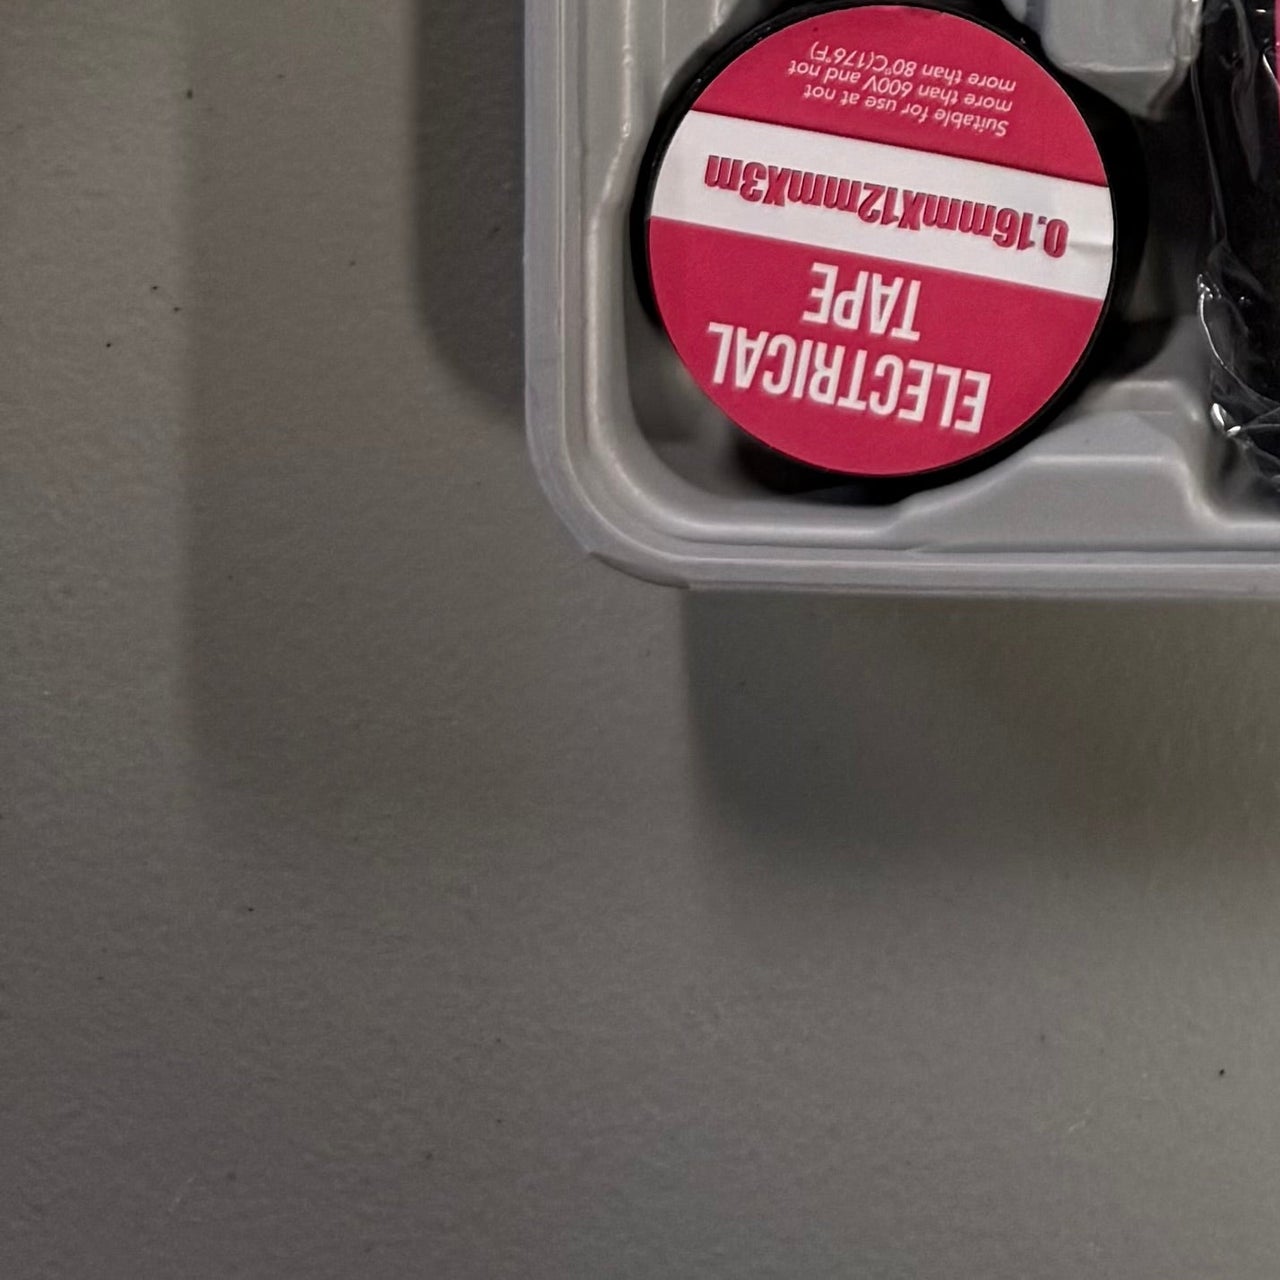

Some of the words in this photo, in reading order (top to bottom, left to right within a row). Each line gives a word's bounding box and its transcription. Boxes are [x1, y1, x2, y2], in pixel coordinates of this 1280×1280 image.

[788, 60, 821, 77] not
[823, 67, 861, 84] and
[922, 64, 962, 86] than
[803, 84, 836, 100] not
[861, 75, 913, 98] 600V
[968, 73, 1016, 92] more
[840, 90, 860, 106] at
[864, 95, 897, 112] use
[918, 84, 958, 106] than
[964, 93, 1013, 112] more
[901, 103, 929, 124] for
[934, 108, 1009, 137] Suitable
[803, 262, 922, 341] TAPE
[707, 322, 992, 434] ELECTRICAL
